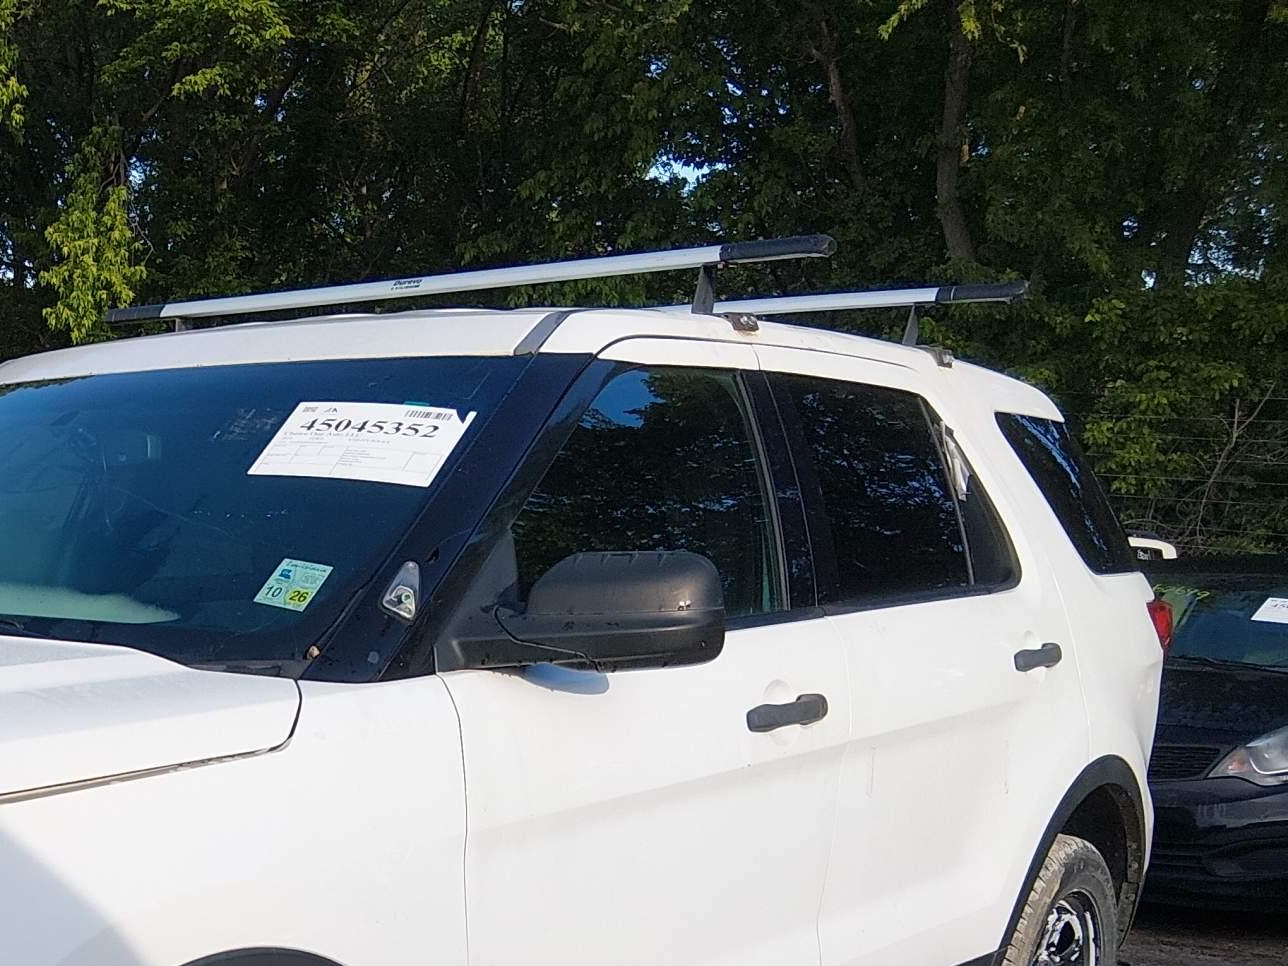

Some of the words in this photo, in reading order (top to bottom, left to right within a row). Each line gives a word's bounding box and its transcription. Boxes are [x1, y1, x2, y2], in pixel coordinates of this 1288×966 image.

[300, 418, 440, 438] 45045352
[265, 585, 283, 598] 10
[289, 590, 309, 603] 26
